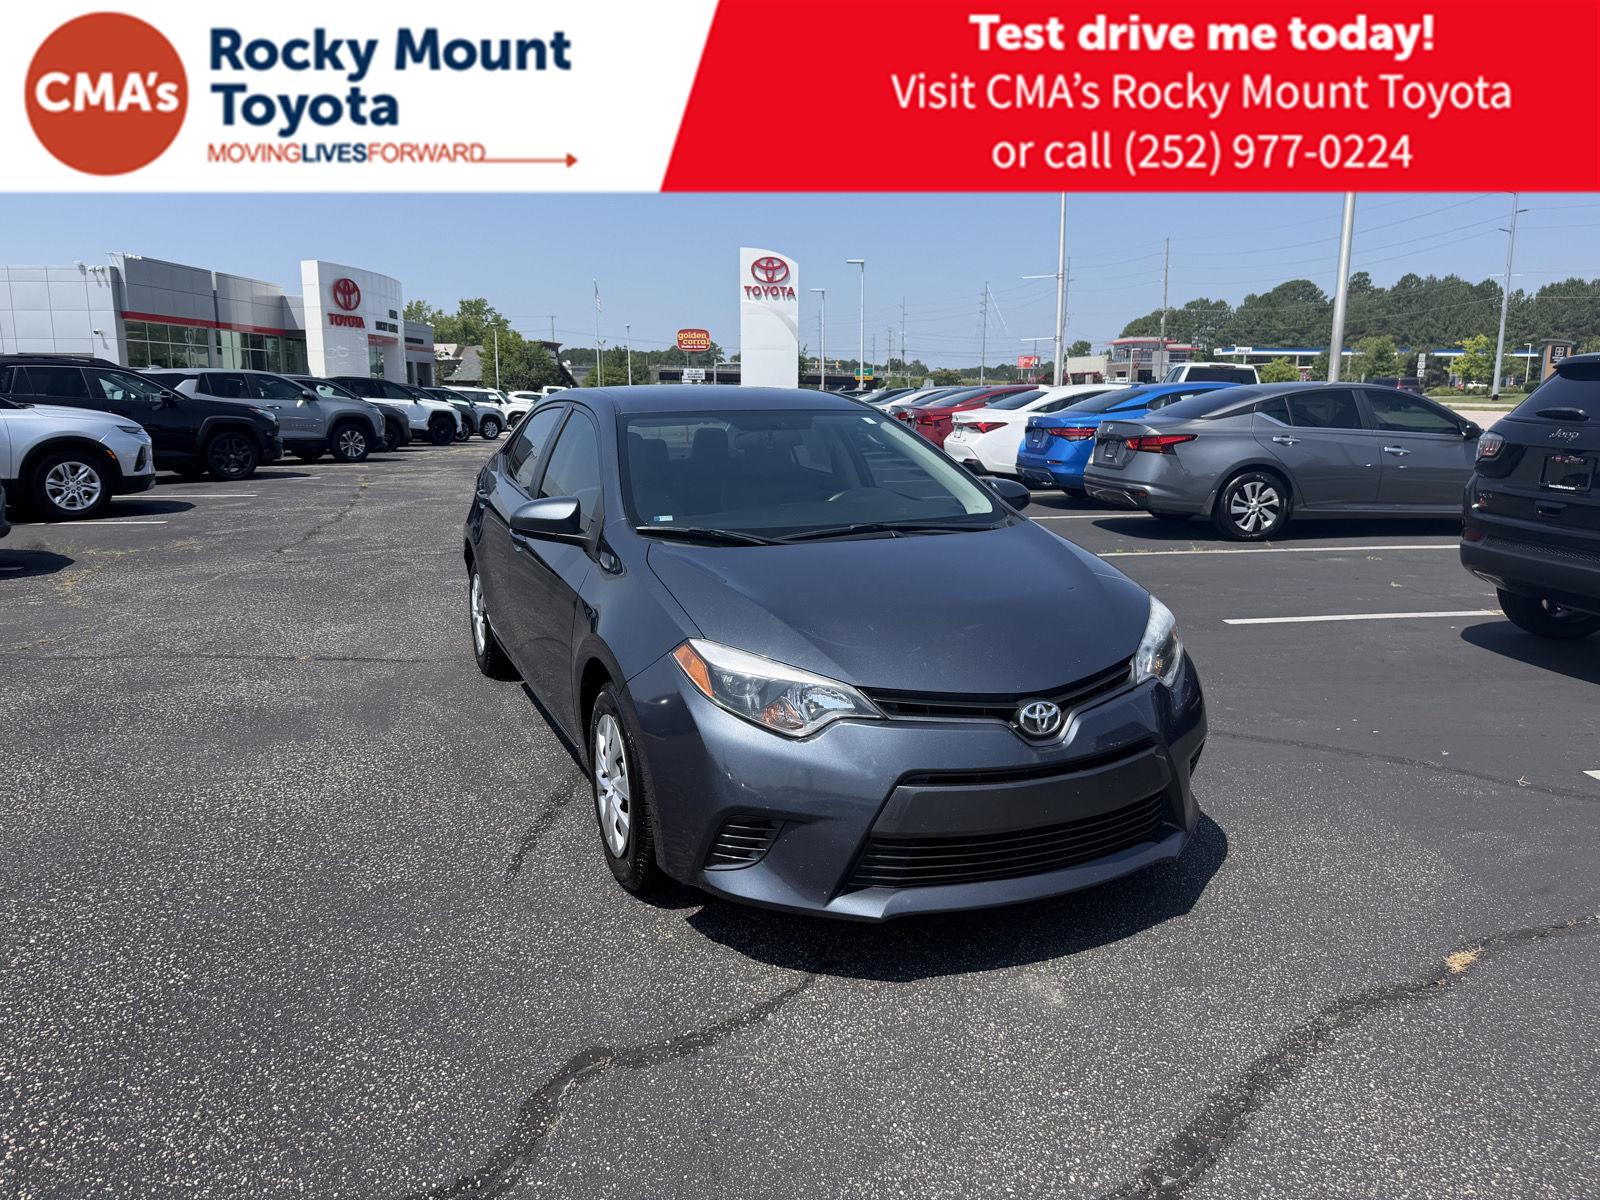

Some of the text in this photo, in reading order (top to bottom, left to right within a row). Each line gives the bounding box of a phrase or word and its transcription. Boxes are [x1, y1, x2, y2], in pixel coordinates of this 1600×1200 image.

[744, 285, 796, 298] TOYOTA
[328, 313, 365, 328] TOYOTA
[678, 331, 707, 341] golden
[1548, 428, 1579, 443] Jeep
